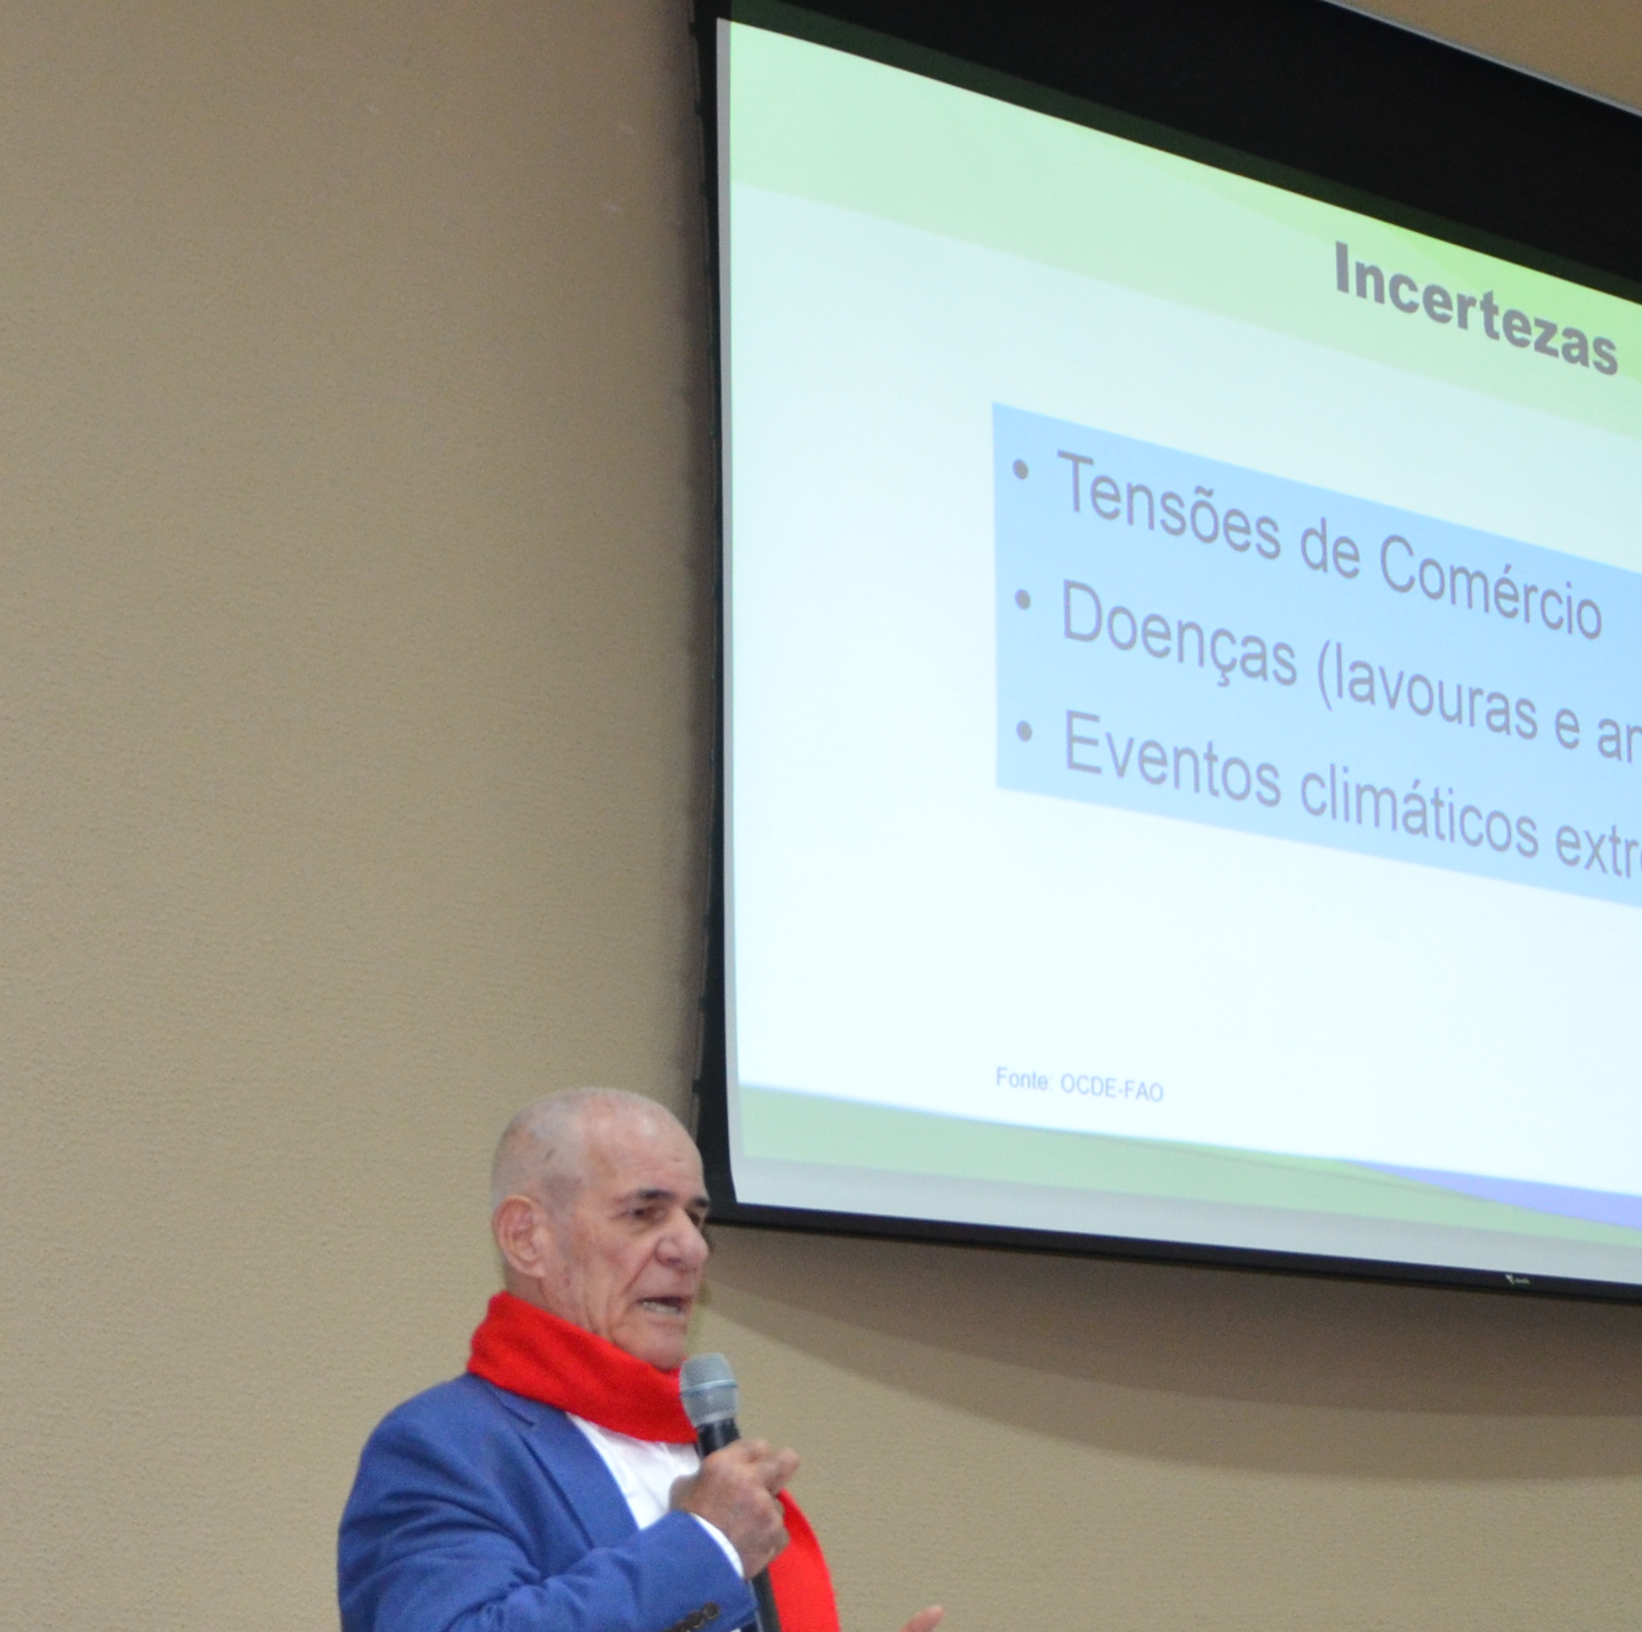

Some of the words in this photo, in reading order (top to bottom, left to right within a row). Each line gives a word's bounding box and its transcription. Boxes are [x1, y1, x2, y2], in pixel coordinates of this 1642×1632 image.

[1334, 241, 1620, 375] Incertezas
[1057, 449, 1282, 562] Tensões
[1300, 516, 1361, 580] de
[1379, 533, 1604, 641] Comércio
[1062, 579, 1298, 687] Doenças
[1316, 638, 1539, 742] (lavouras
[1555, 710, 1582, 751] e
[1065, 709, 1282, 808] Eventos
[1300, 762, 1540, 858] climáticos
[995, 1066, 1055, 1093] Fonte:
[1060, 1072, 1165, 1103] OCDE-FAO
